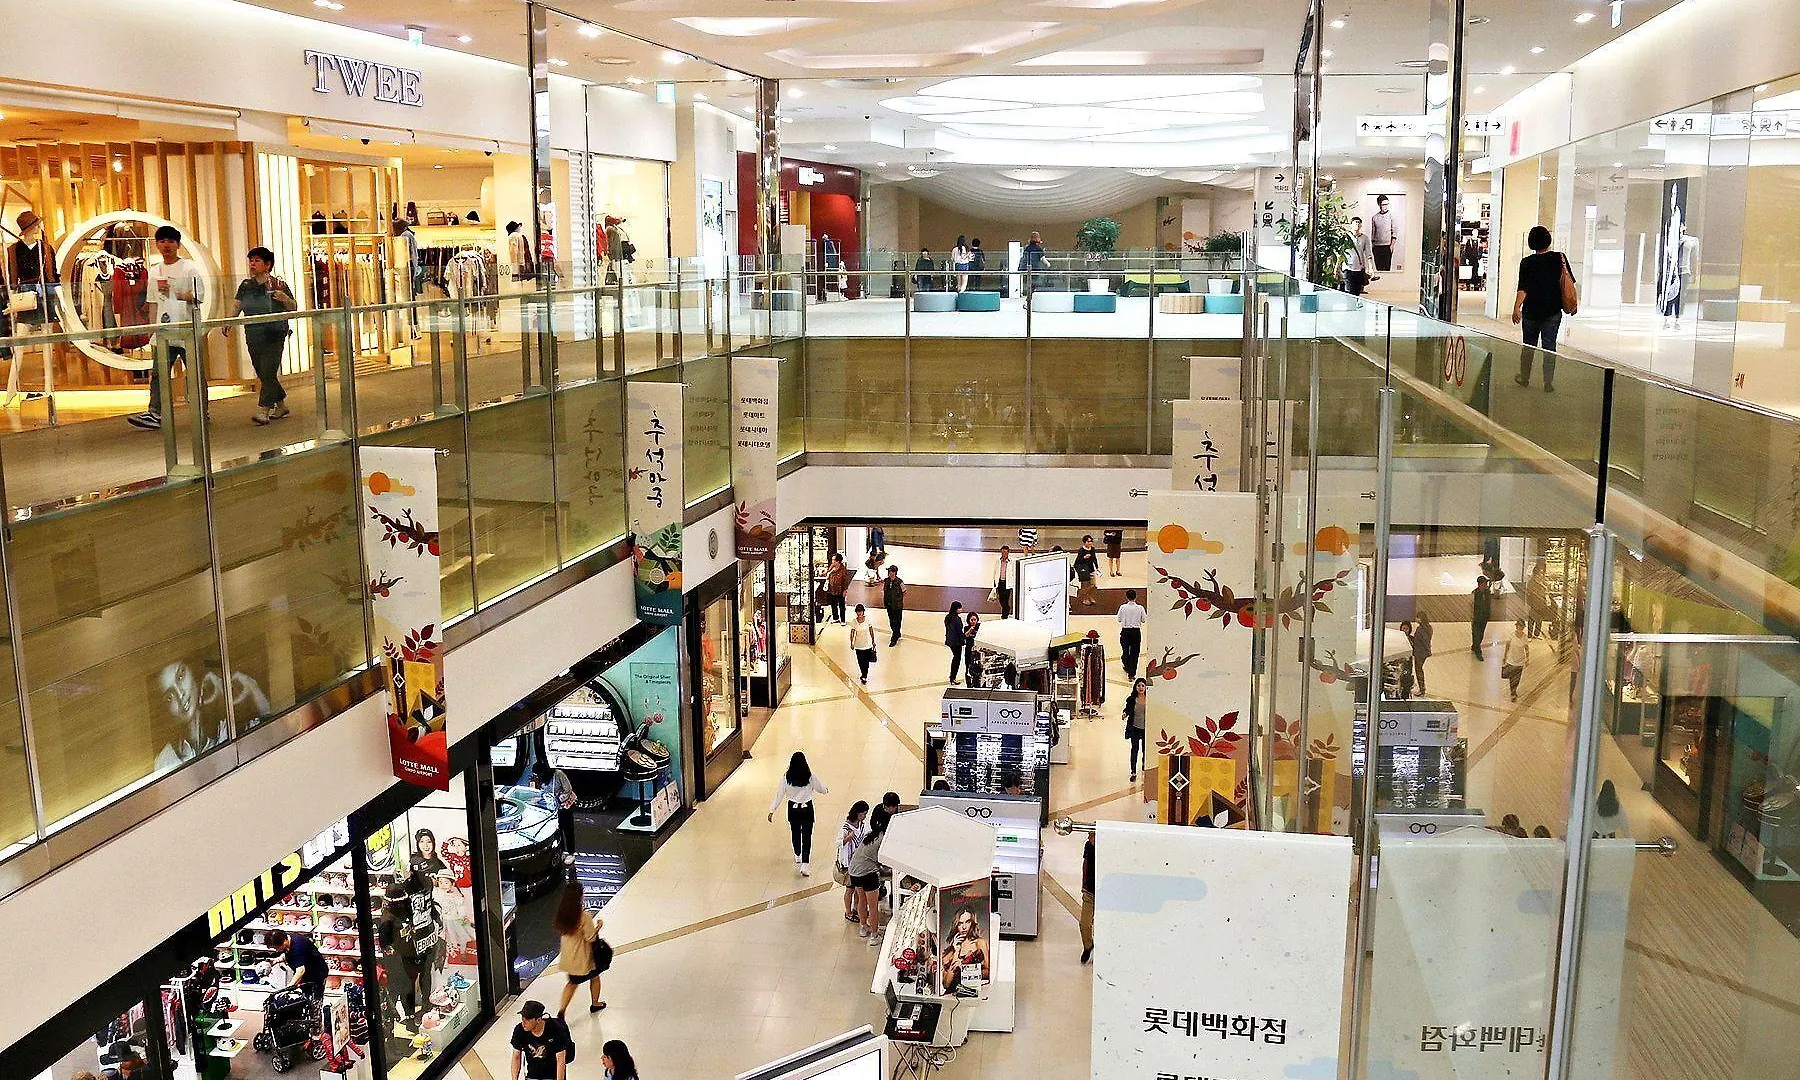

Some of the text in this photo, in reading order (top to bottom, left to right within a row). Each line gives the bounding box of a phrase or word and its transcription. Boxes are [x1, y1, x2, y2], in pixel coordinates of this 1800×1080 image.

[304, 49, 424, 107] TWEE
[399, 757, 440, 774] LOTTE MALL
[1142, 1007, 1287, 1045] 롯데백화점
